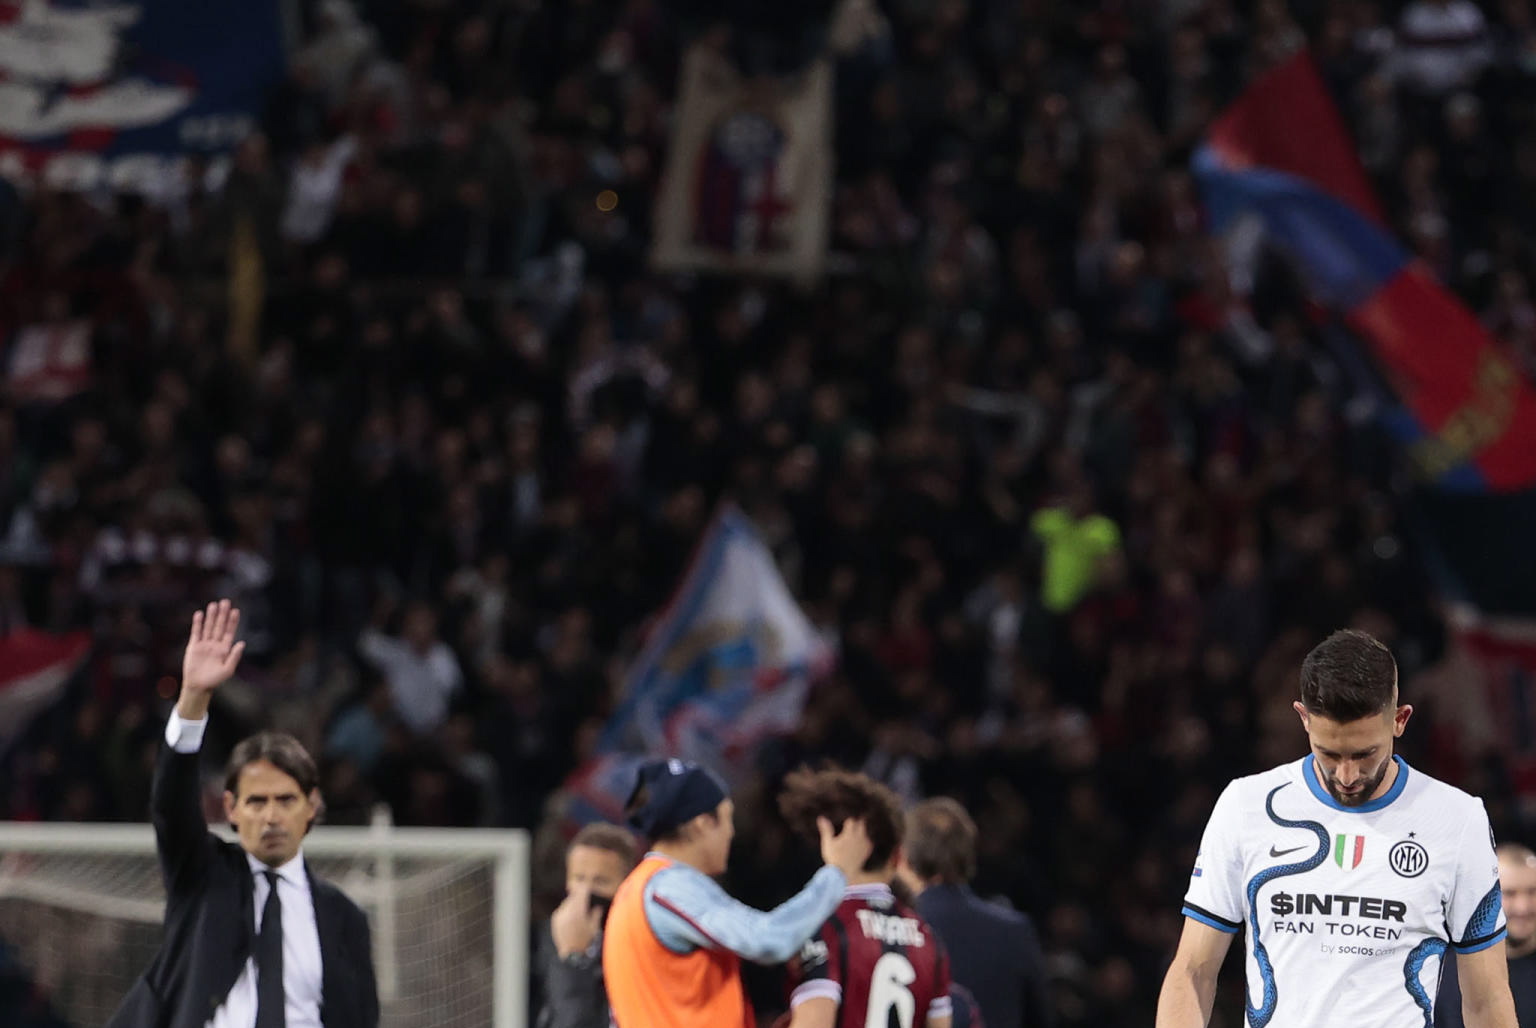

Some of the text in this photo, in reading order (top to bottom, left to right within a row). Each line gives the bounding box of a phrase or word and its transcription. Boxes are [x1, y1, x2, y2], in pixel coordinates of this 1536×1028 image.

[1270, 891, 1407, 923] $INTER
[1274, 921, 1402, 941] FAN TOKEN
